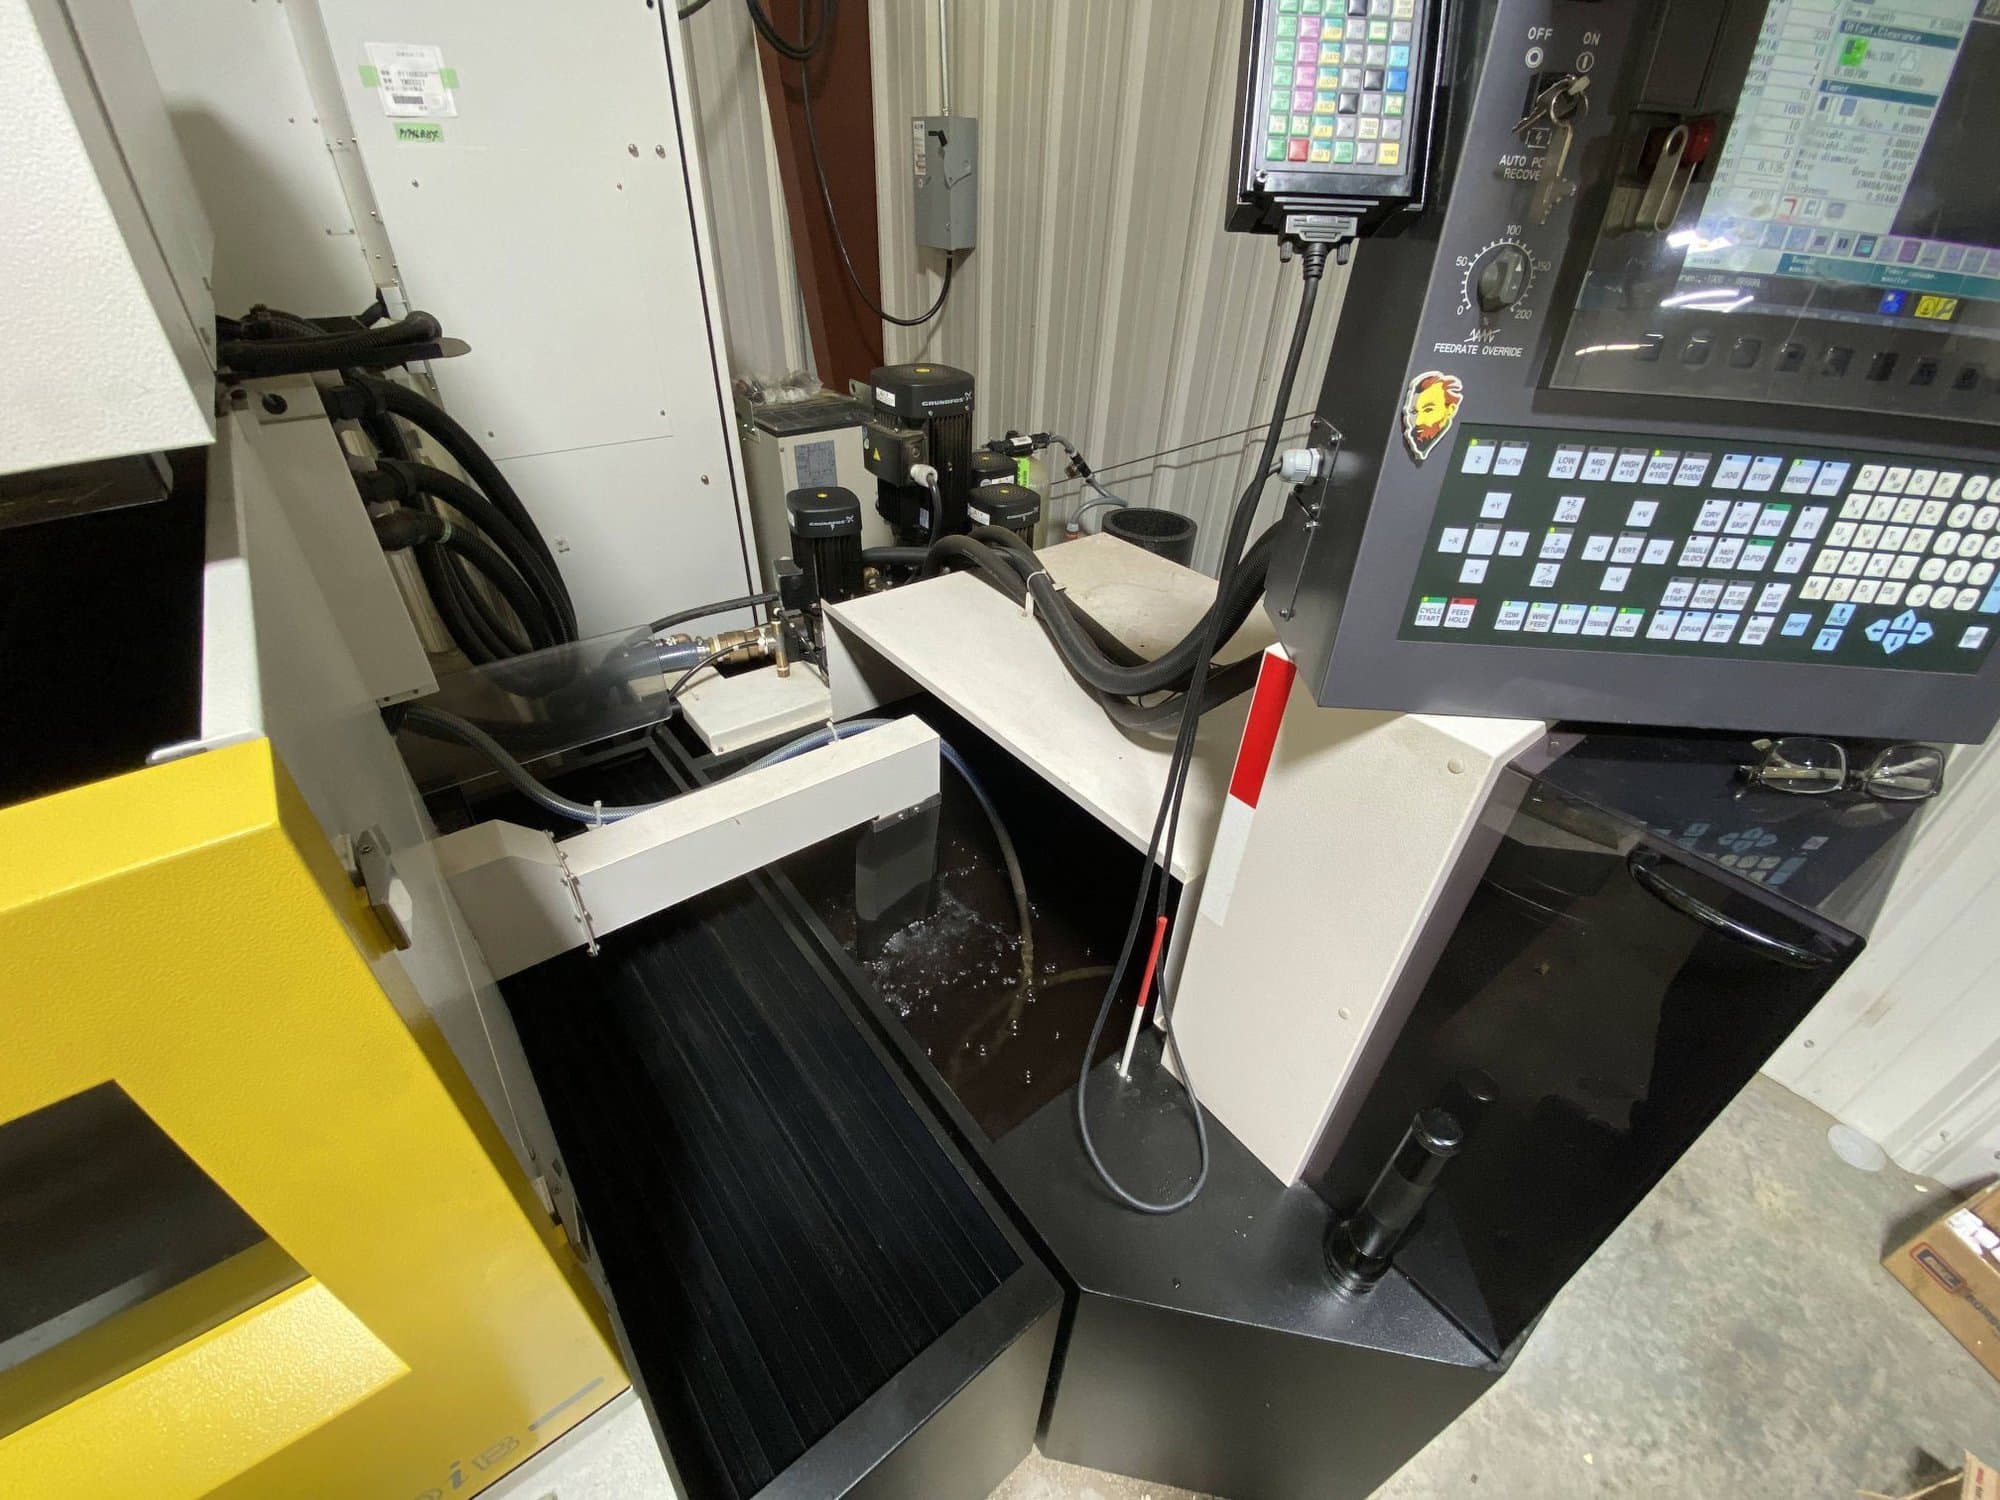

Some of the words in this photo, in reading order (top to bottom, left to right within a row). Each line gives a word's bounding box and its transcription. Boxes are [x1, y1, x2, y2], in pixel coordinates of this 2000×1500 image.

[1527, 27, 1553, 41] OFF
[1583, 32, 1601, 45] ON
[1499, 155, 1527, 167] AUTO
[1503, 167, 1541, 181] RECOVE
[1506, 225, 1522, 236] 100
[1455, 256, 1468, 267] 50
[1537, 261, 1552, 272] 150
[1456, 305, 1464, 316] 0
[1514, 310, 1532, 320] 200
[1433, 342, 1479, 356] FEEDRATE
[1481, 345, 1523, 358] OVERRIDE
[1558, 457, 1576, 465] LOW
[1591, 458, 1606, 466] MID
[1620, 460, 1641, 468] HIGH
[1650, 462, 1674, 471] RAPID
[1682, 464, 1705, 472] RAPID
[1704, 511, 1720, 519] DRY
[1731, 521, 1749, 529] SKIP
[1530, 620, 1546, 628] FEED
